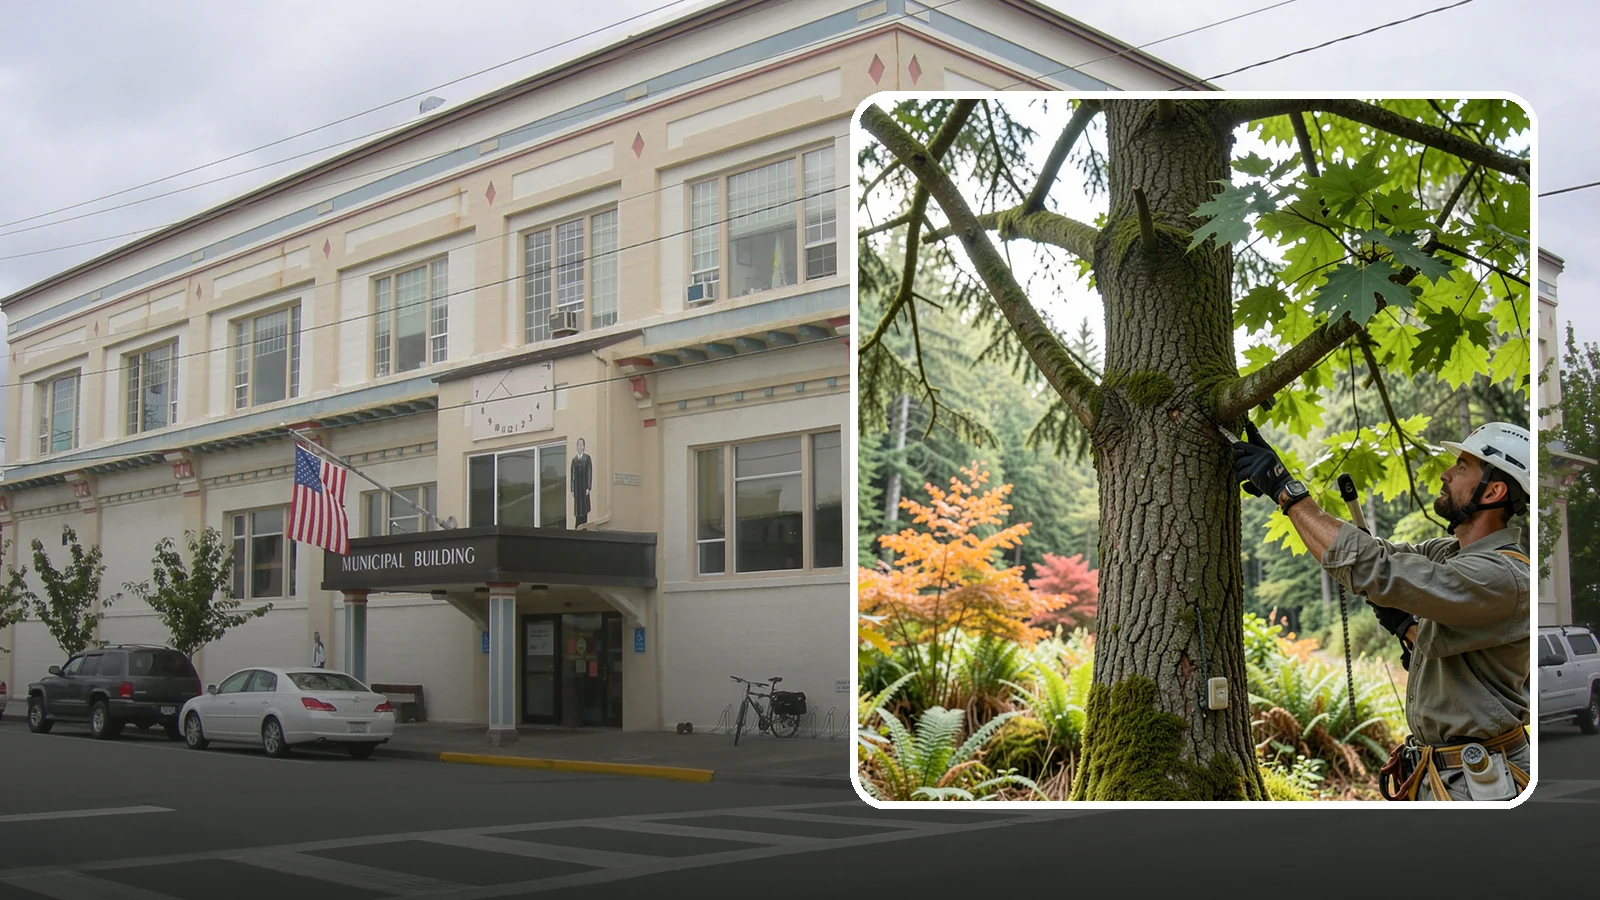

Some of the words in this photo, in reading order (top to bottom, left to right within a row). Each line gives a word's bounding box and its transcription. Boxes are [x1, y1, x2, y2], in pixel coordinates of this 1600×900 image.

[475, 389, 480, 398] 7
[535, 402, 540, 410] 4
[480, 407, 485, 415] 8
[487, 418, 492, 426] 9
[528, 414, 533, 422] 3
[521, 420, 526, 428] 2
[342, 552, 405, 572] MUNICIPAL
[414, 546, 475, 567] BUILDING
